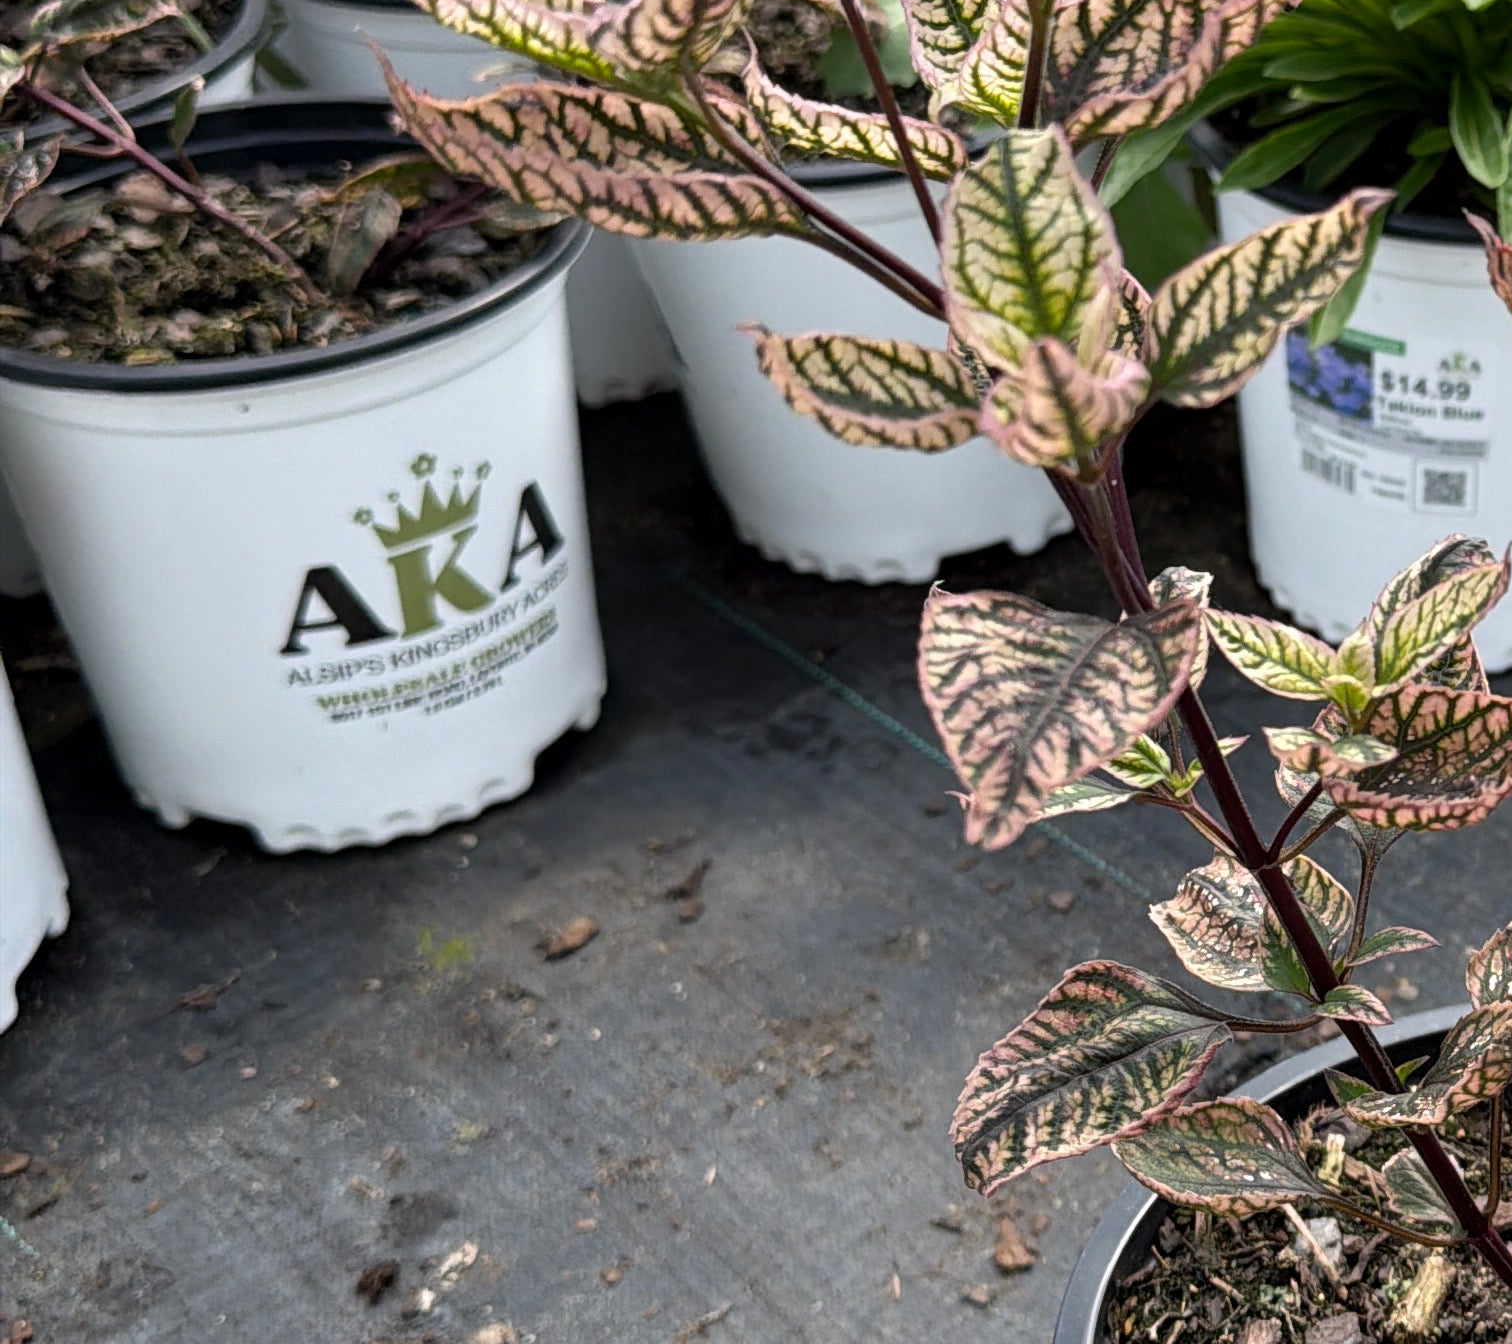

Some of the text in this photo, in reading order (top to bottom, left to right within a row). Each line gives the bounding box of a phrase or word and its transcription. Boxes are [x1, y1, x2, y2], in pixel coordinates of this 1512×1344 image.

[1380, 370, 1471, 401] $14.99
[1442, 406, 1485, 421] Blue
[279, 479, 565, 656] AKA
[391, 601, 519, 670] KINGSBURY
